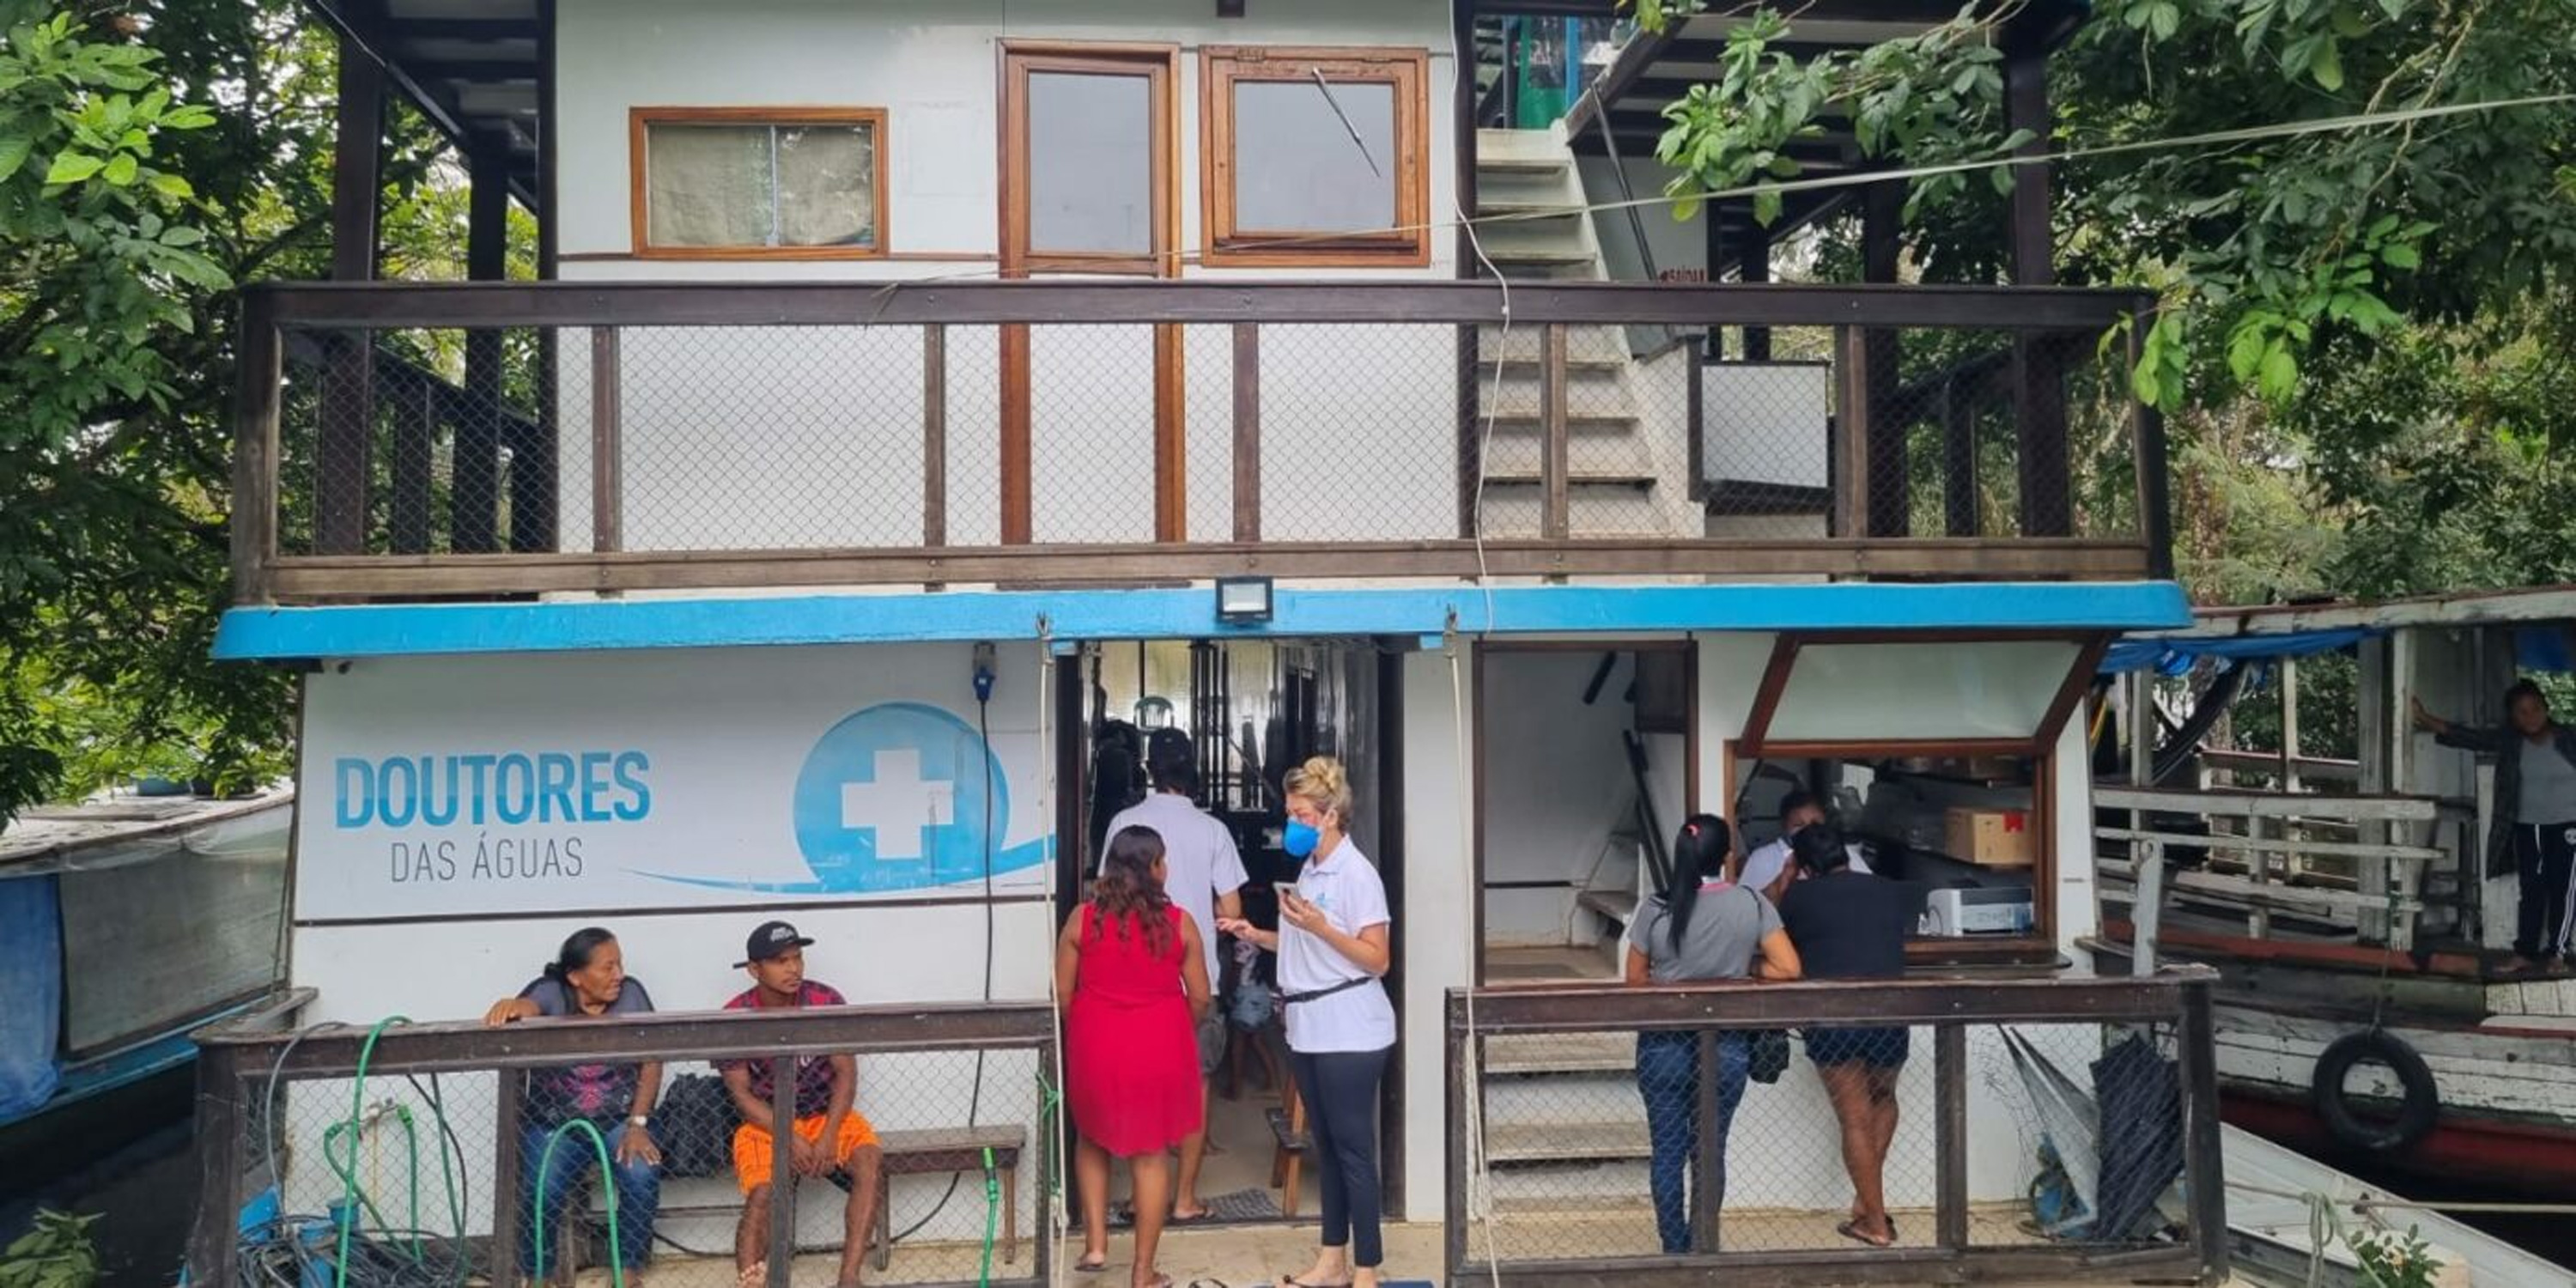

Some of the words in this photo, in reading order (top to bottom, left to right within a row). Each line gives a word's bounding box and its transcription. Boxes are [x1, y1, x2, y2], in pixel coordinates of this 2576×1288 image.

[335, 750, 650, 829] DOUTORES
[391, 840, 456, 883] DAS
[471, 831, 584, 879] ÁGUAS
